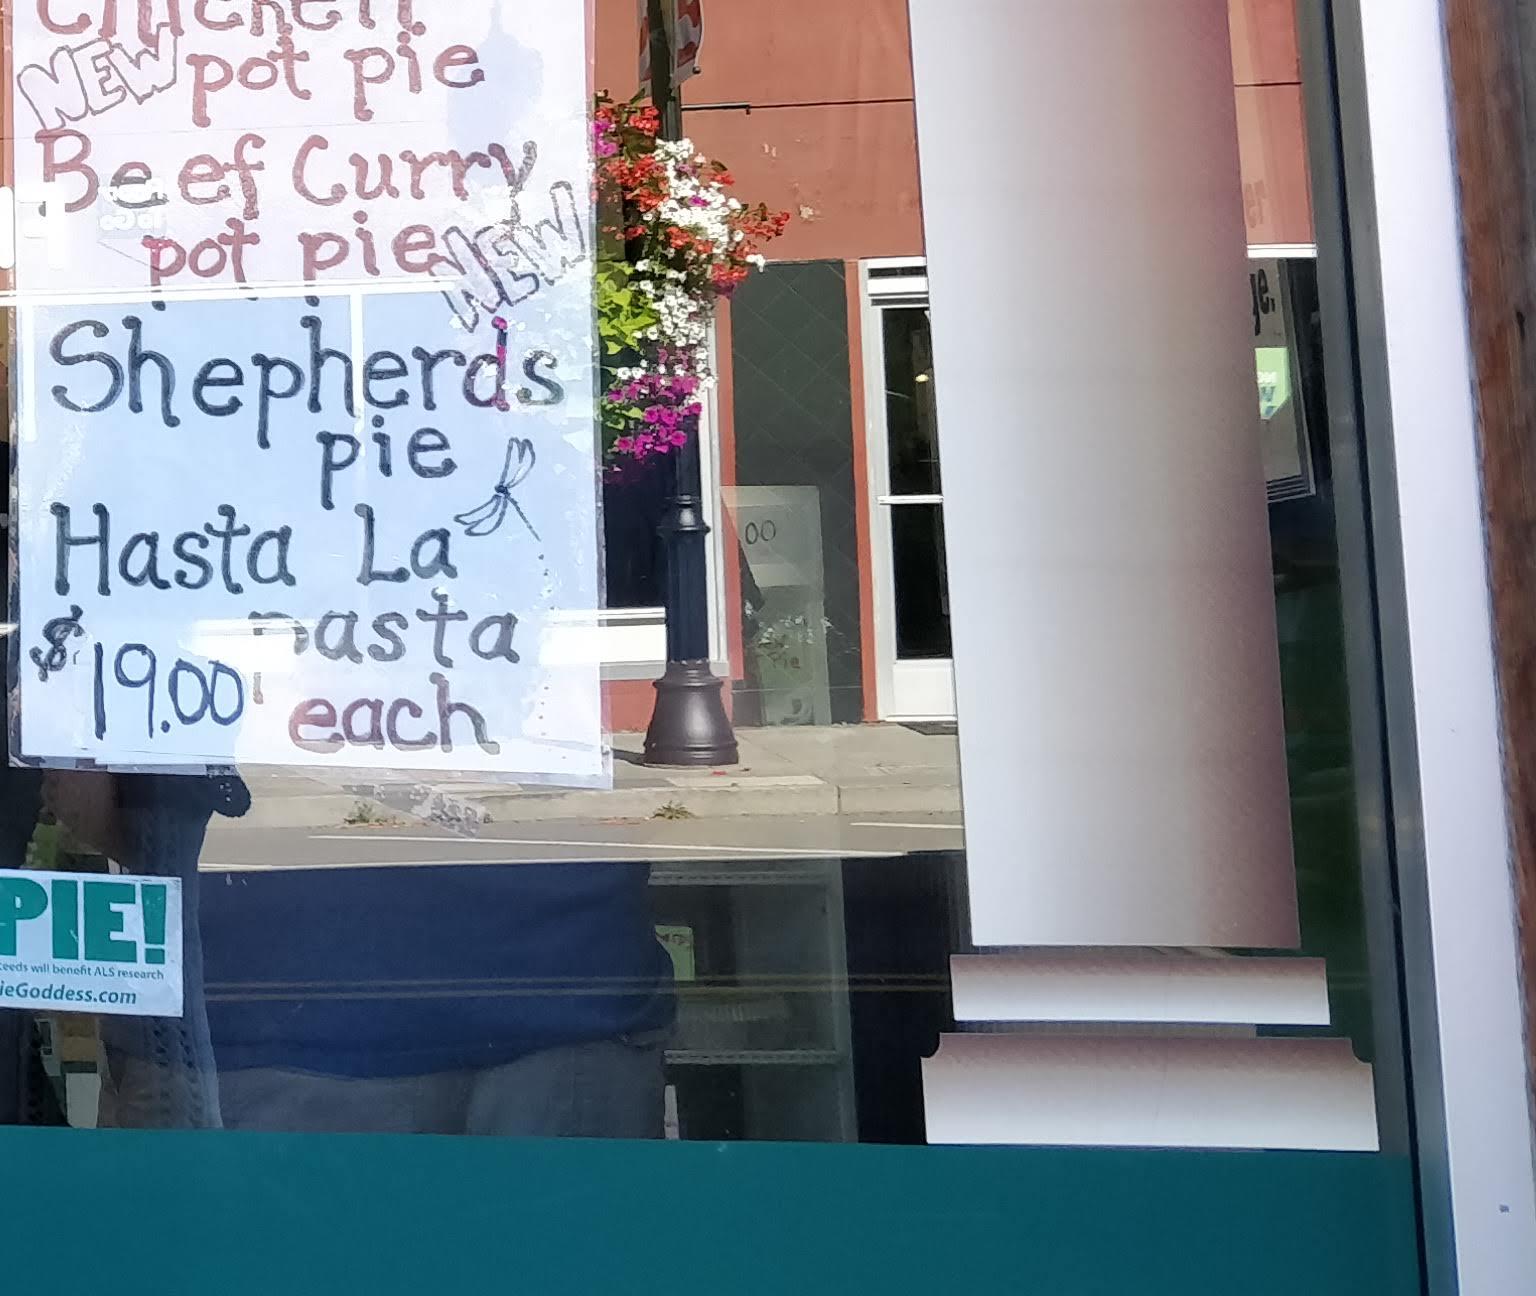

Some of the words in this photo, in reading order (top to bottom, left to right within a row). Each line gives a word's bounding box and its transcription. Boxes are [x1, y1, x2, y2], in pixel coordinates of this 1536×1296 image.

[17, 22, 177, 130] NEW
[186, 32, 311, 126] pot
[344, 28, 485, 121] pie
[35, 129, 264, 219] Beef
[292, 135, 538, 229] Curry
[142, 219, 260, 309] pot
[298, 210, 440, 306] pie
[429, 181, 589, 332] NEW
[51, 316, 565, 448] Shepherds
[316, 415, 458, 509] pie
[50, 503, 296, 595] Hasta
[354, 503, 458, 585] La
[29, 605, 245, 739] $19.00
[288, 672, 501, 754] each
[31, 964, 50, 973] will
[52, 963, 92, 977] benefit
[94, 965, 115, 978] ALS
[117, 967, 165, 980] research
